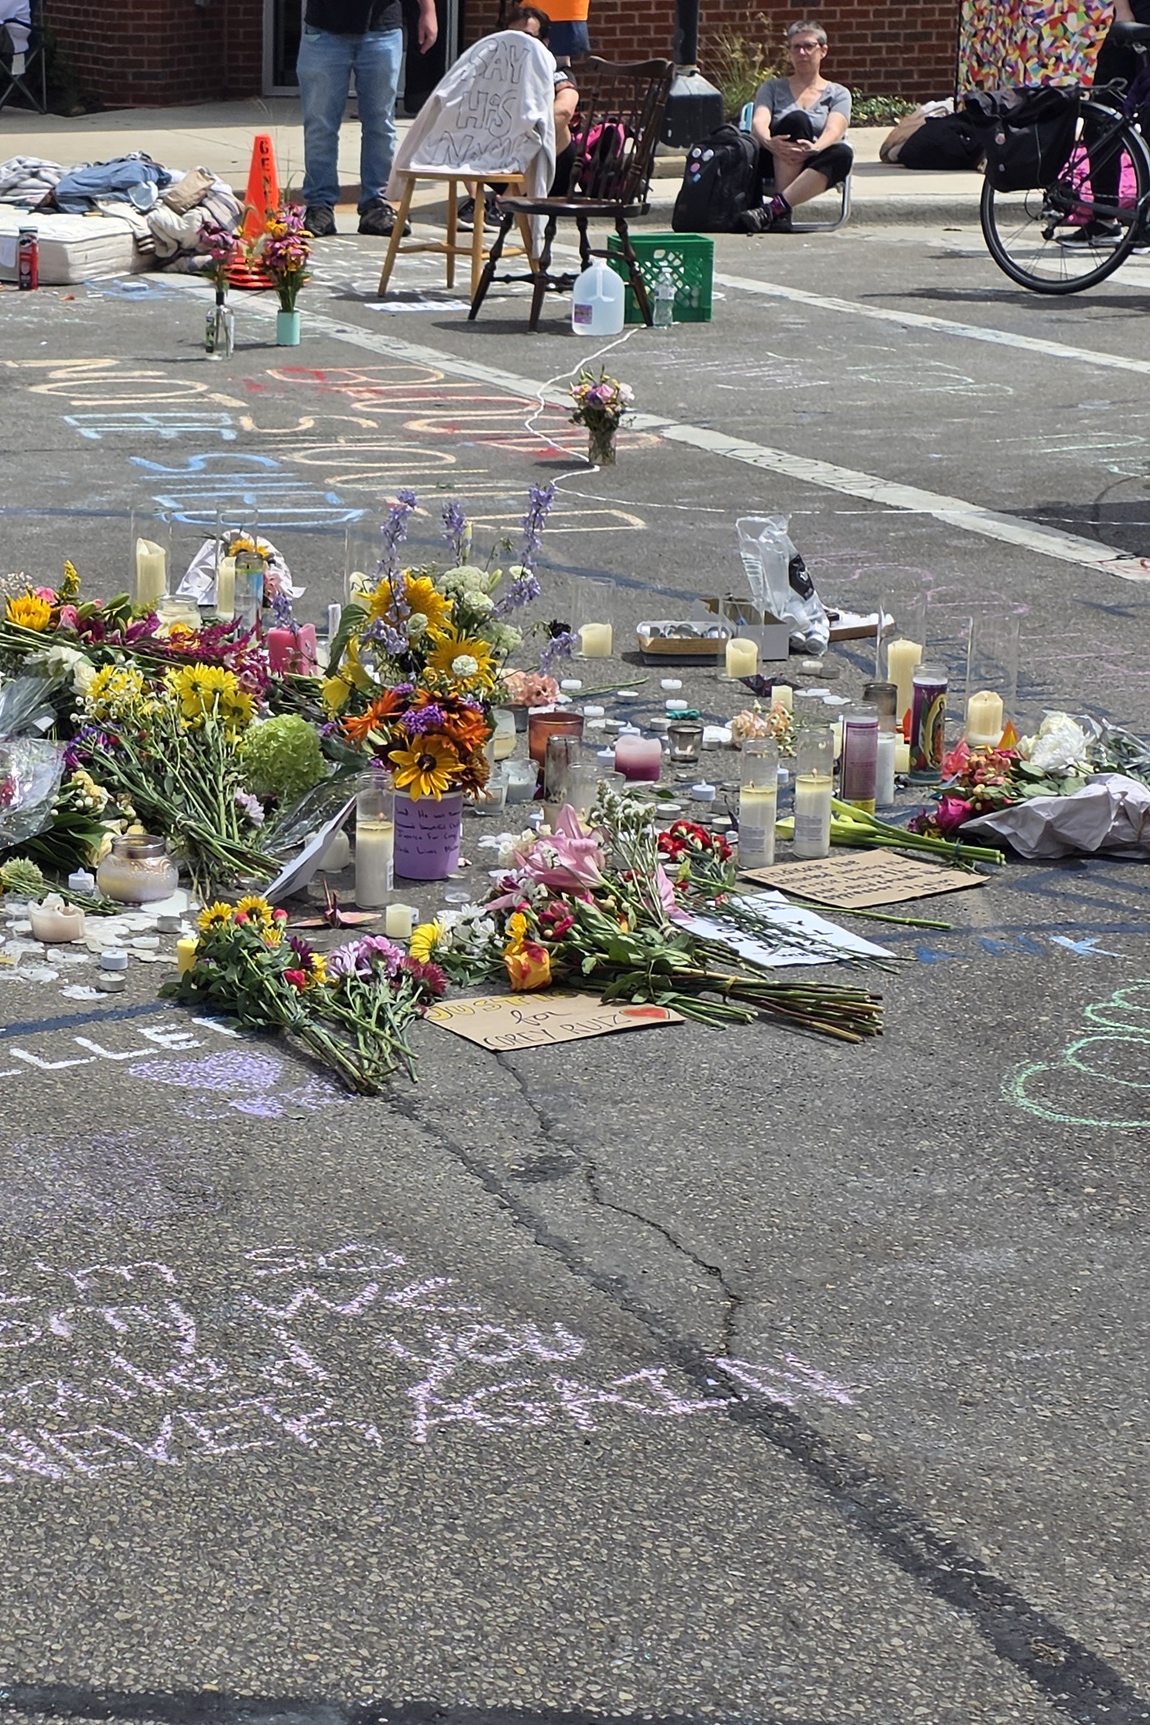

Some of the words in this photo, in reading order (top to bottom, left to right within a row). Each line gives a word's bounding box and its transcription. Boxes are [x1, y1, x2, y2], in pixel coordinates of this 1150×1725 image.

[128, 452, 370, 528] SHED
[482, 1028, 556, 1049] COREY
[559, 1013, 632, 1036] RUIZ
[510, 1009, 572, 1027] for
